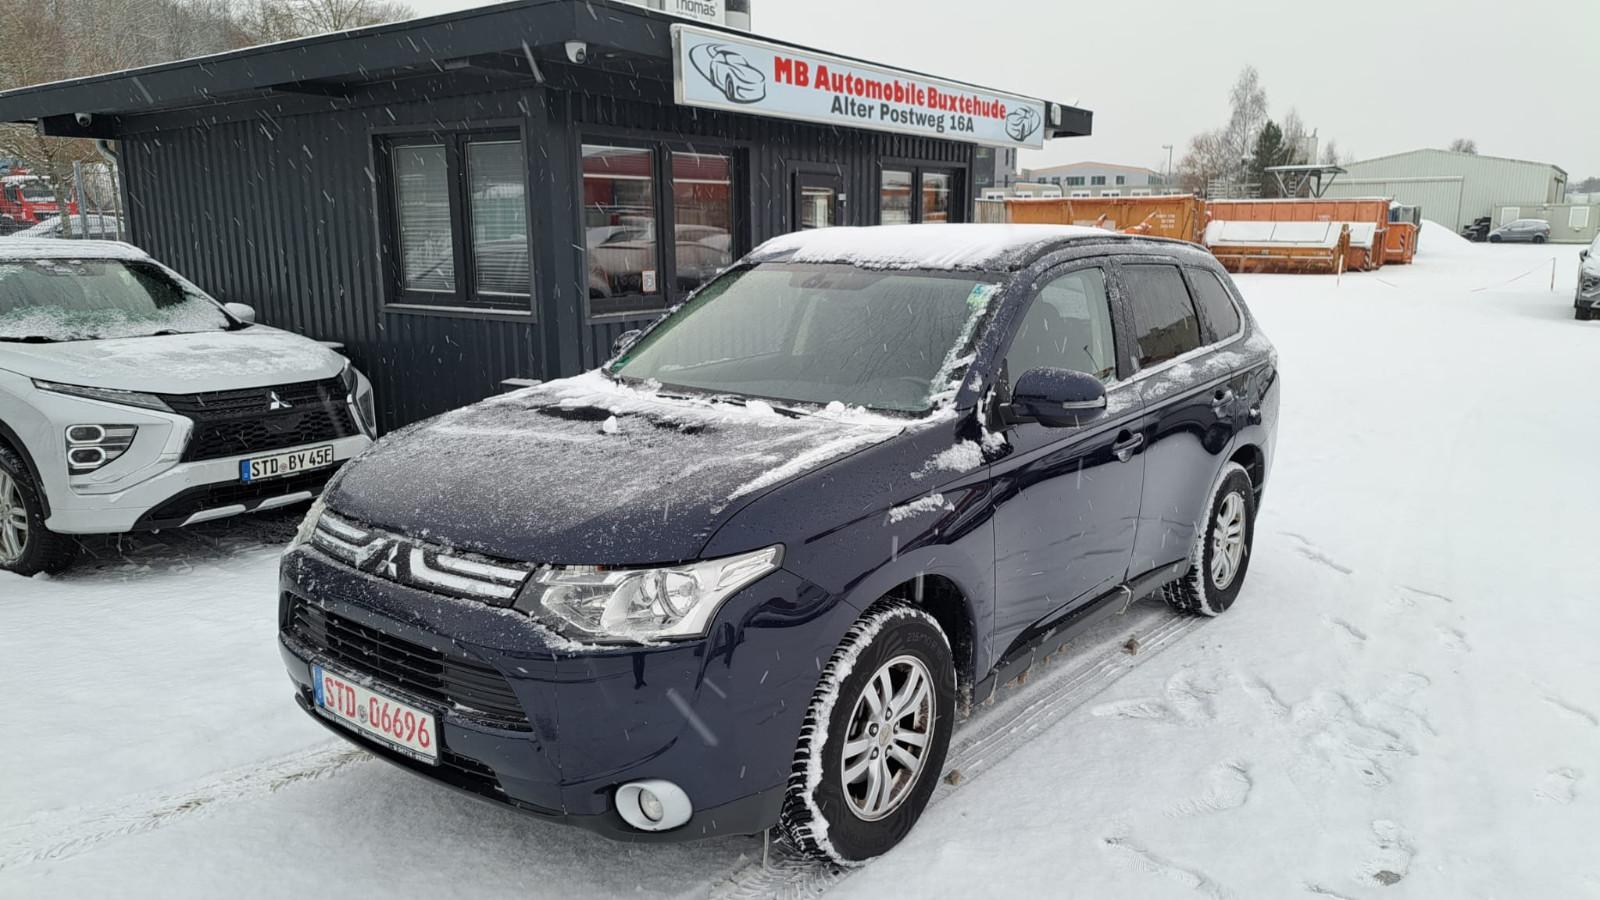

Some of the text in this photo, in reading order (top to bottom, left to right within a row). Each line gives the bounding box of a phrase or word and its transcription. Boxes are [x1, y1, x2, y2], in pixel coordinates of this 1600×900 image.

[774, 55, 1006, 120] MB Automobile Buxtehude
[831, 95, 974, 133] Alter Postweg 16A
[251, 448, 332, 477] STD BY 45E
[324, 677, 430, 748] STD 06696
